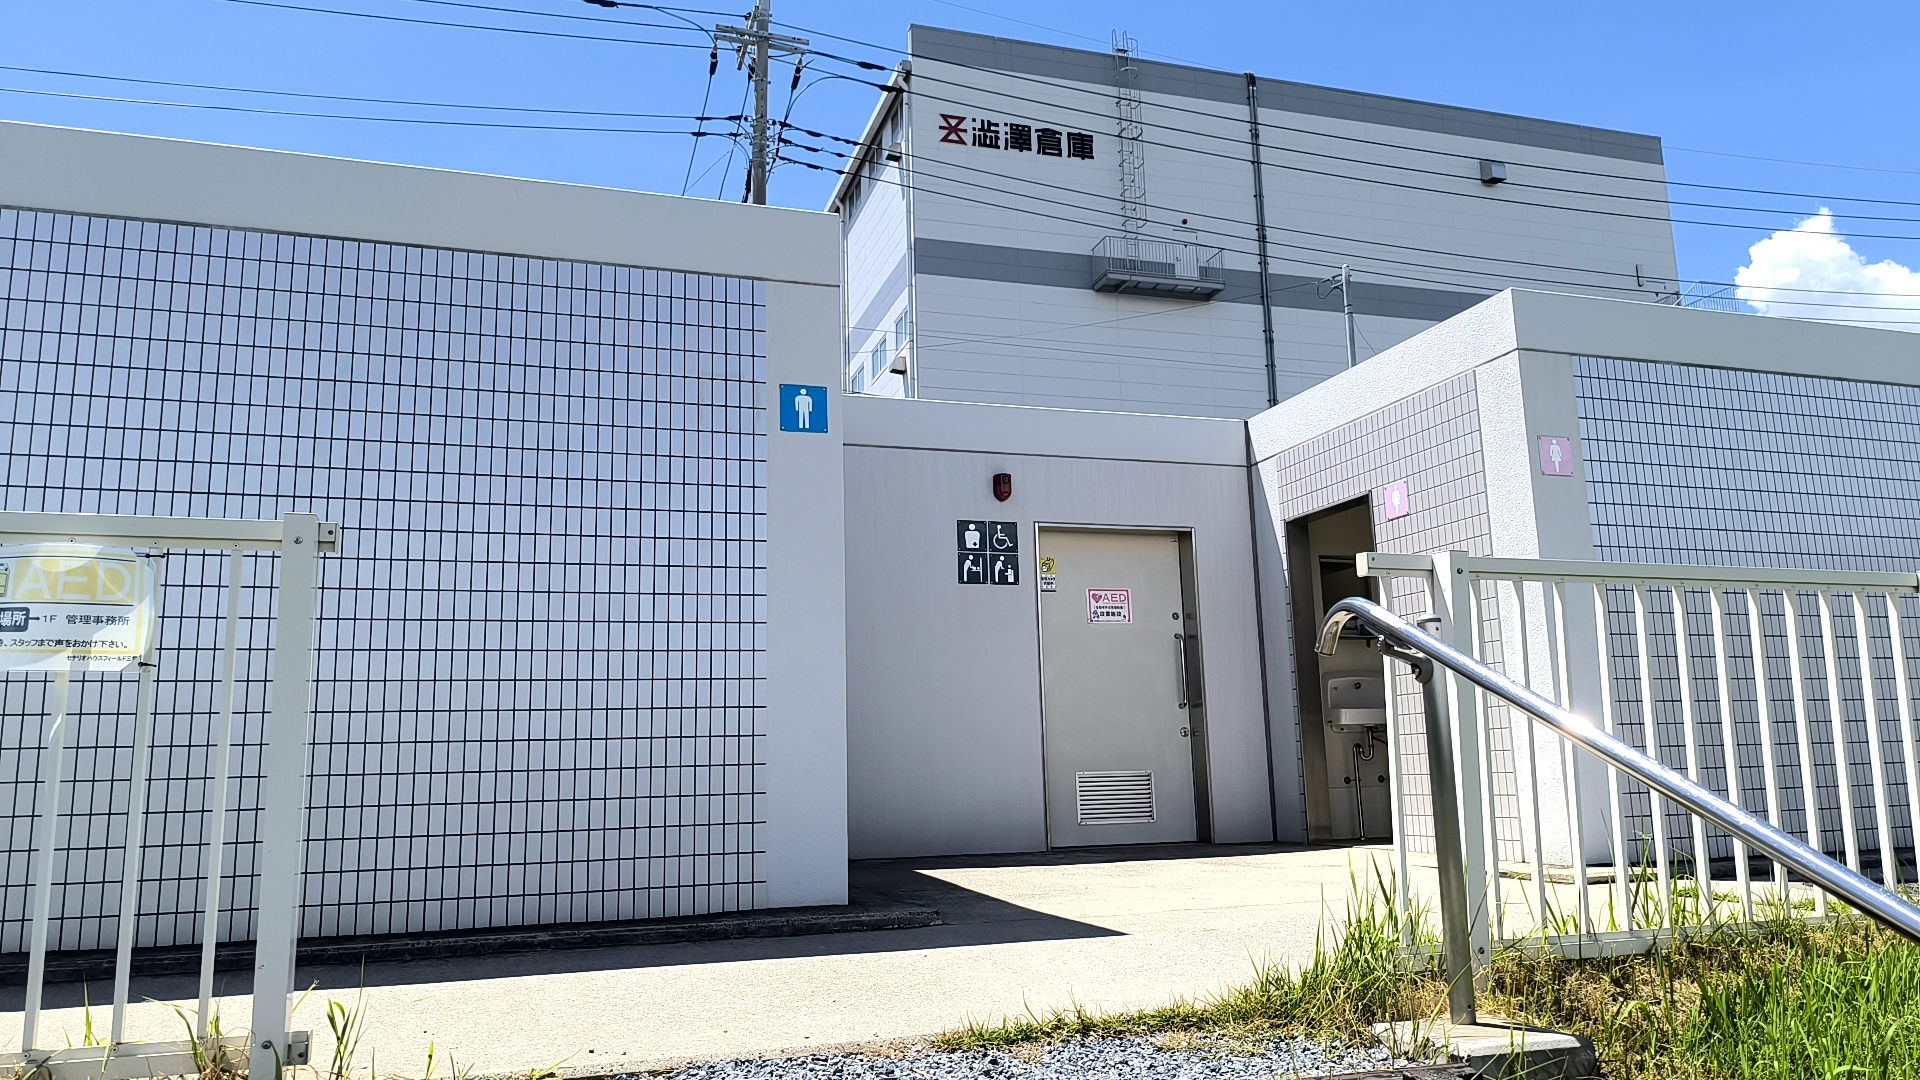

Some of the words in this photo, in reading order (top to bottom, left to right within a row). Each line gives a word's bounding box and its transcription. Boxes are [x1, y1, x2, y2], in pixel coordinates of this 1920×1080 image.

[16, 559, 131, 601] AED
[1103, 593, 1126, 602] AED
[66, 614, 130, 625] 管理事務所
